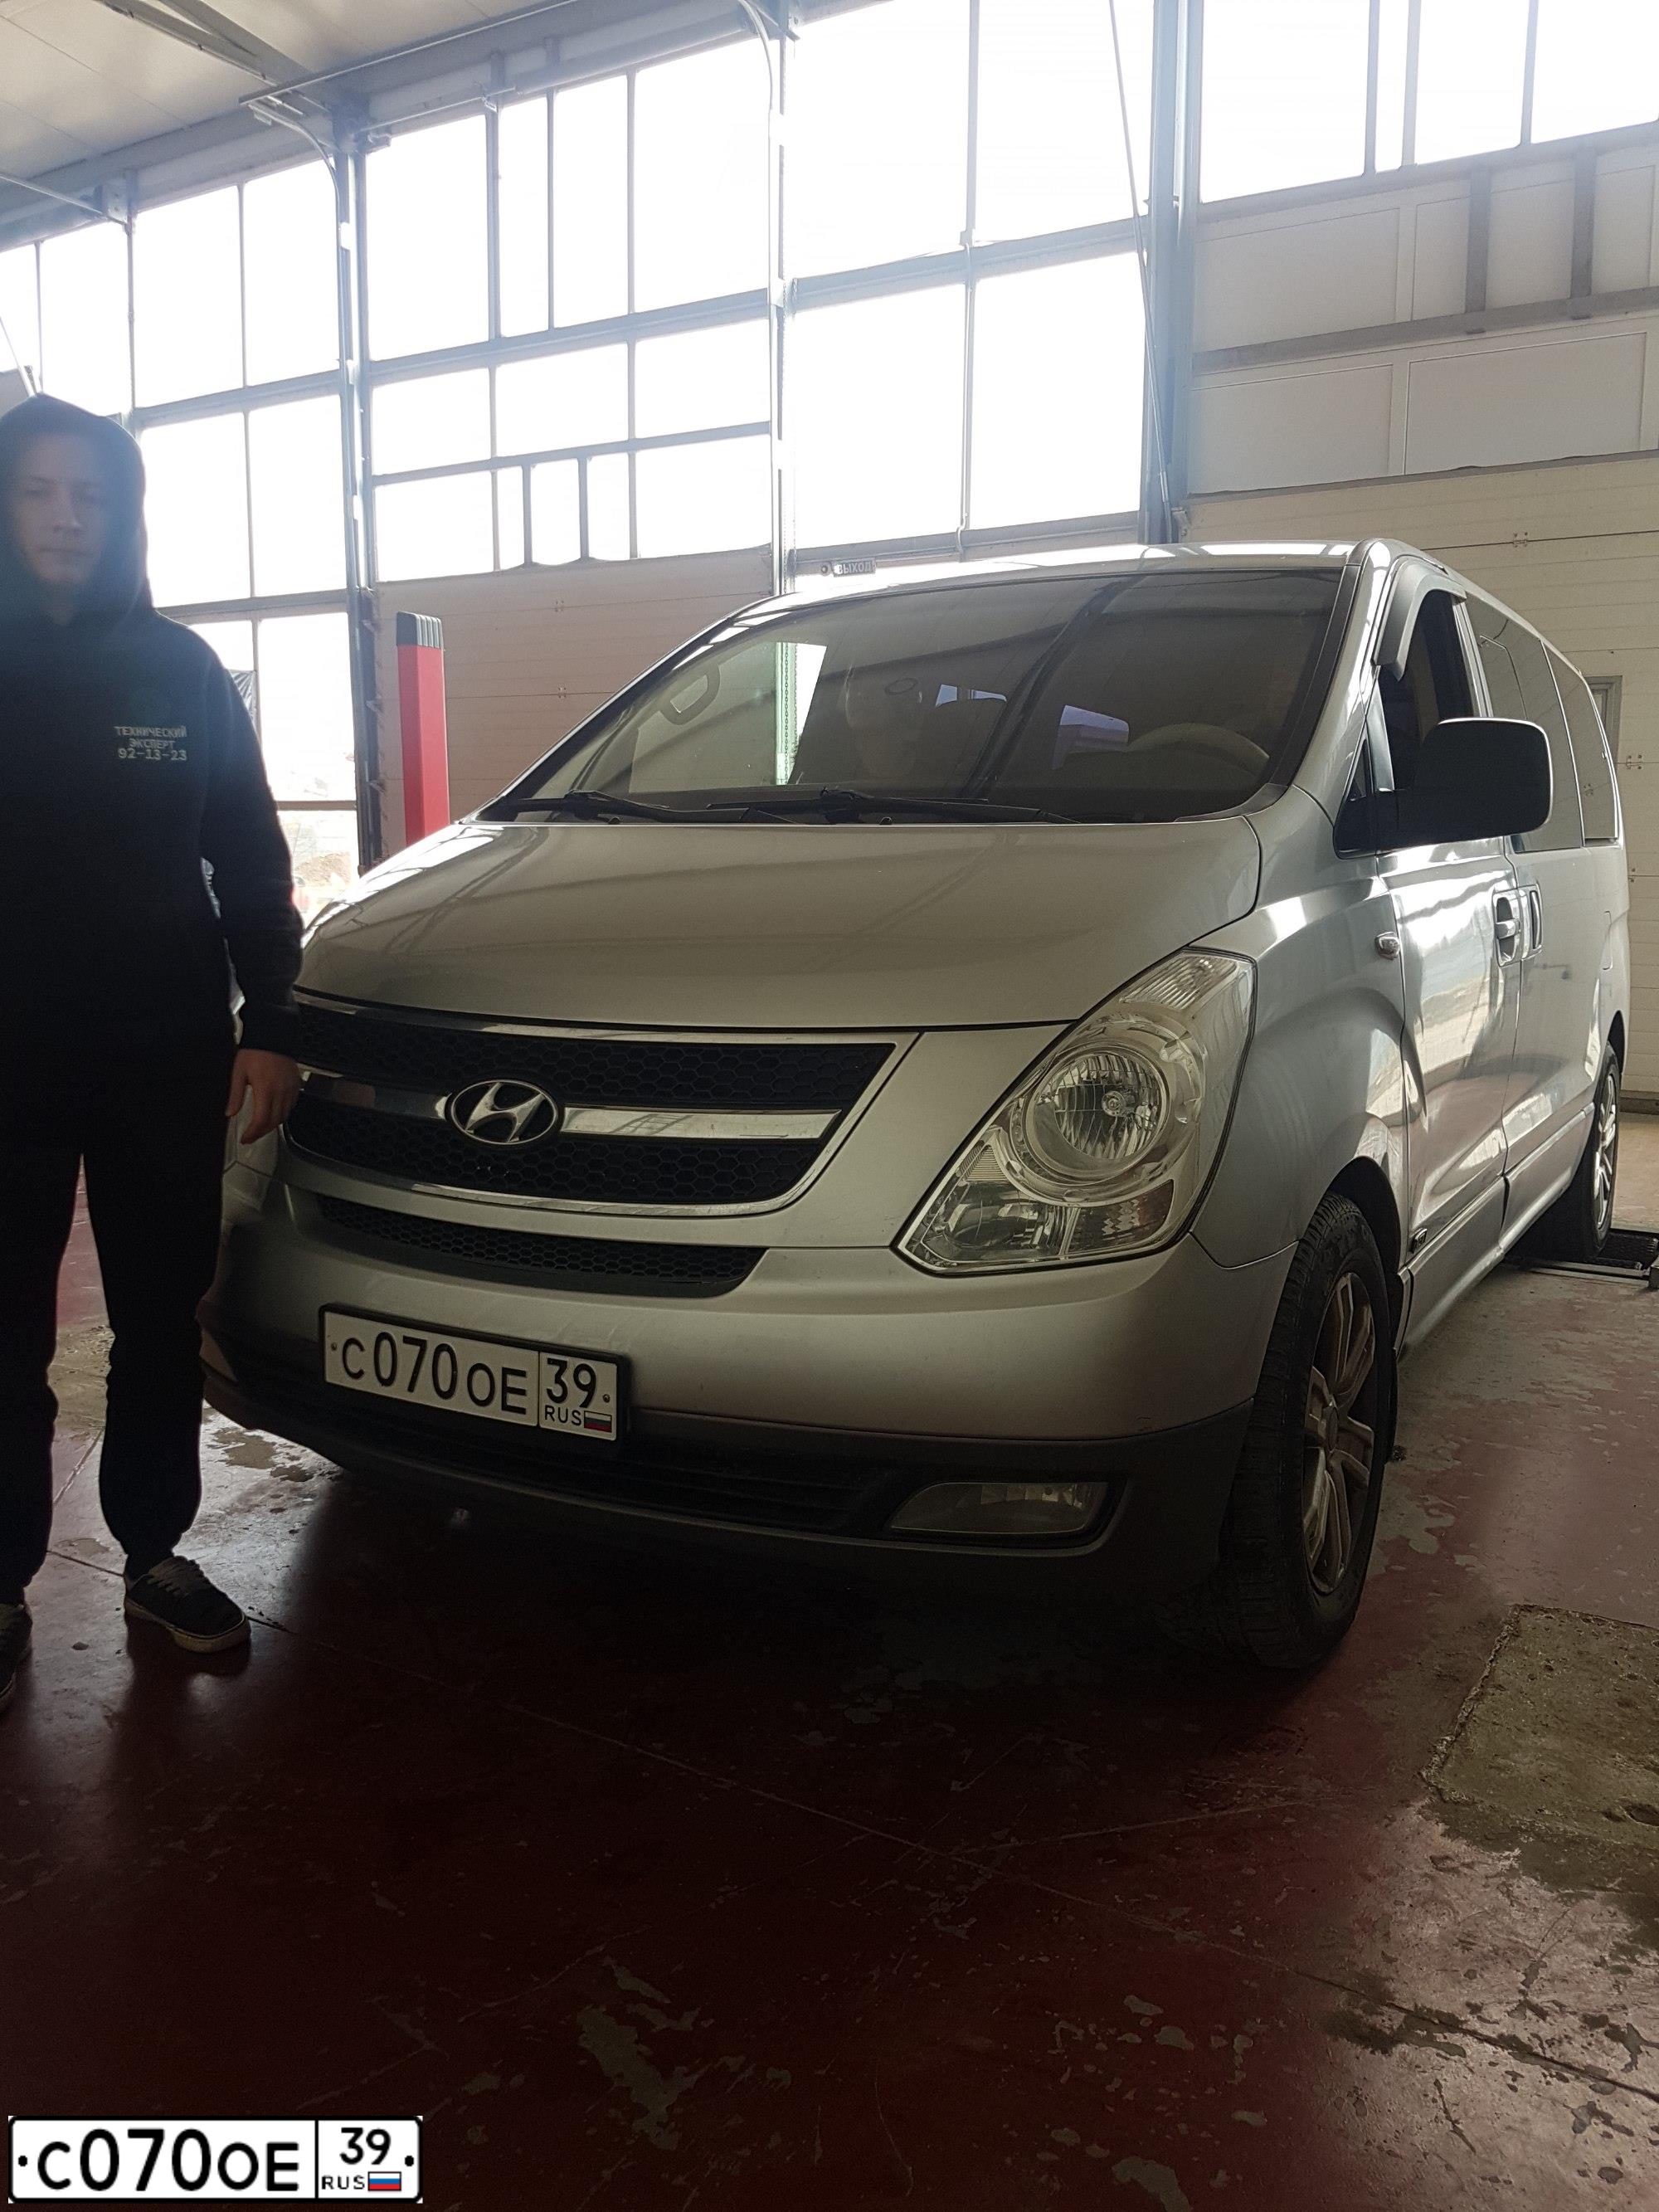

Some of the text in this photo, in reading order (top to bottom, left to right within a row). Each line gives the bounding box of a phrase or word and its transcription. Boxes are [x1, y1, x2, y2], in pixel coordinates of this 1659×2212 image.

[836, 561, 873, 574] ВЫХОД
[114, 725, 187, 738] ТЕХНИЧЕСКИЙ
[129, 738, 175, 749] ЭКСПЕРТ
[118, 748, 187, 761] 92-13-23
[546, 1357, 597, 1408] 39
[544, 1406, 581, 1426] RUS
